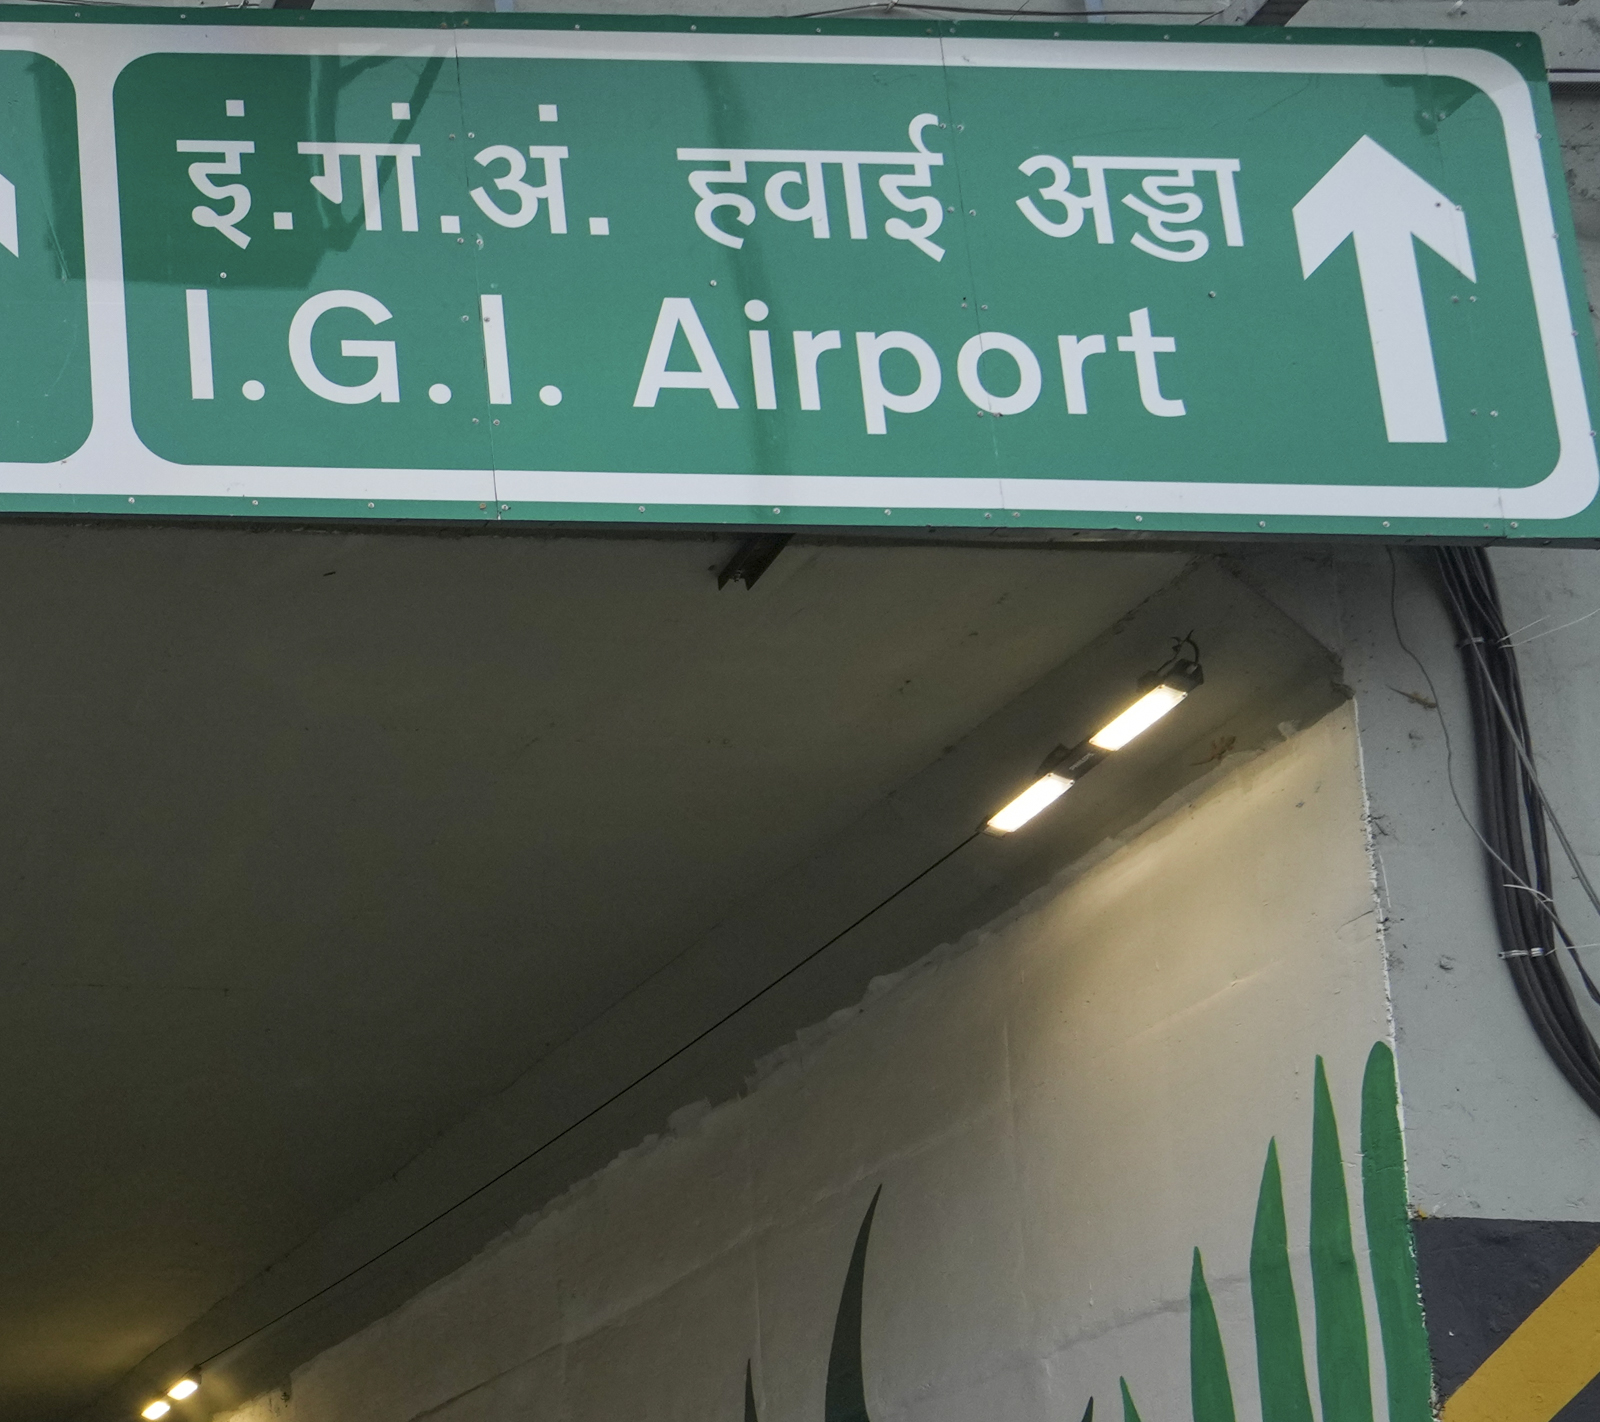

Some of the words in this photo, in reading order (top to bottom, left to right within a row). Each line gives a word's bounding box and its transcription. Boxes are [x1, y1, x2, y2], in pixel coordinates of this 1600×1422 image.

[676, 113, 946, 262] हवाई
[1015, 154, 1244, 263] अड्डा
[185, 289, 563, 407] I.G.I.
[632, 297, 1186, 435] Airport
